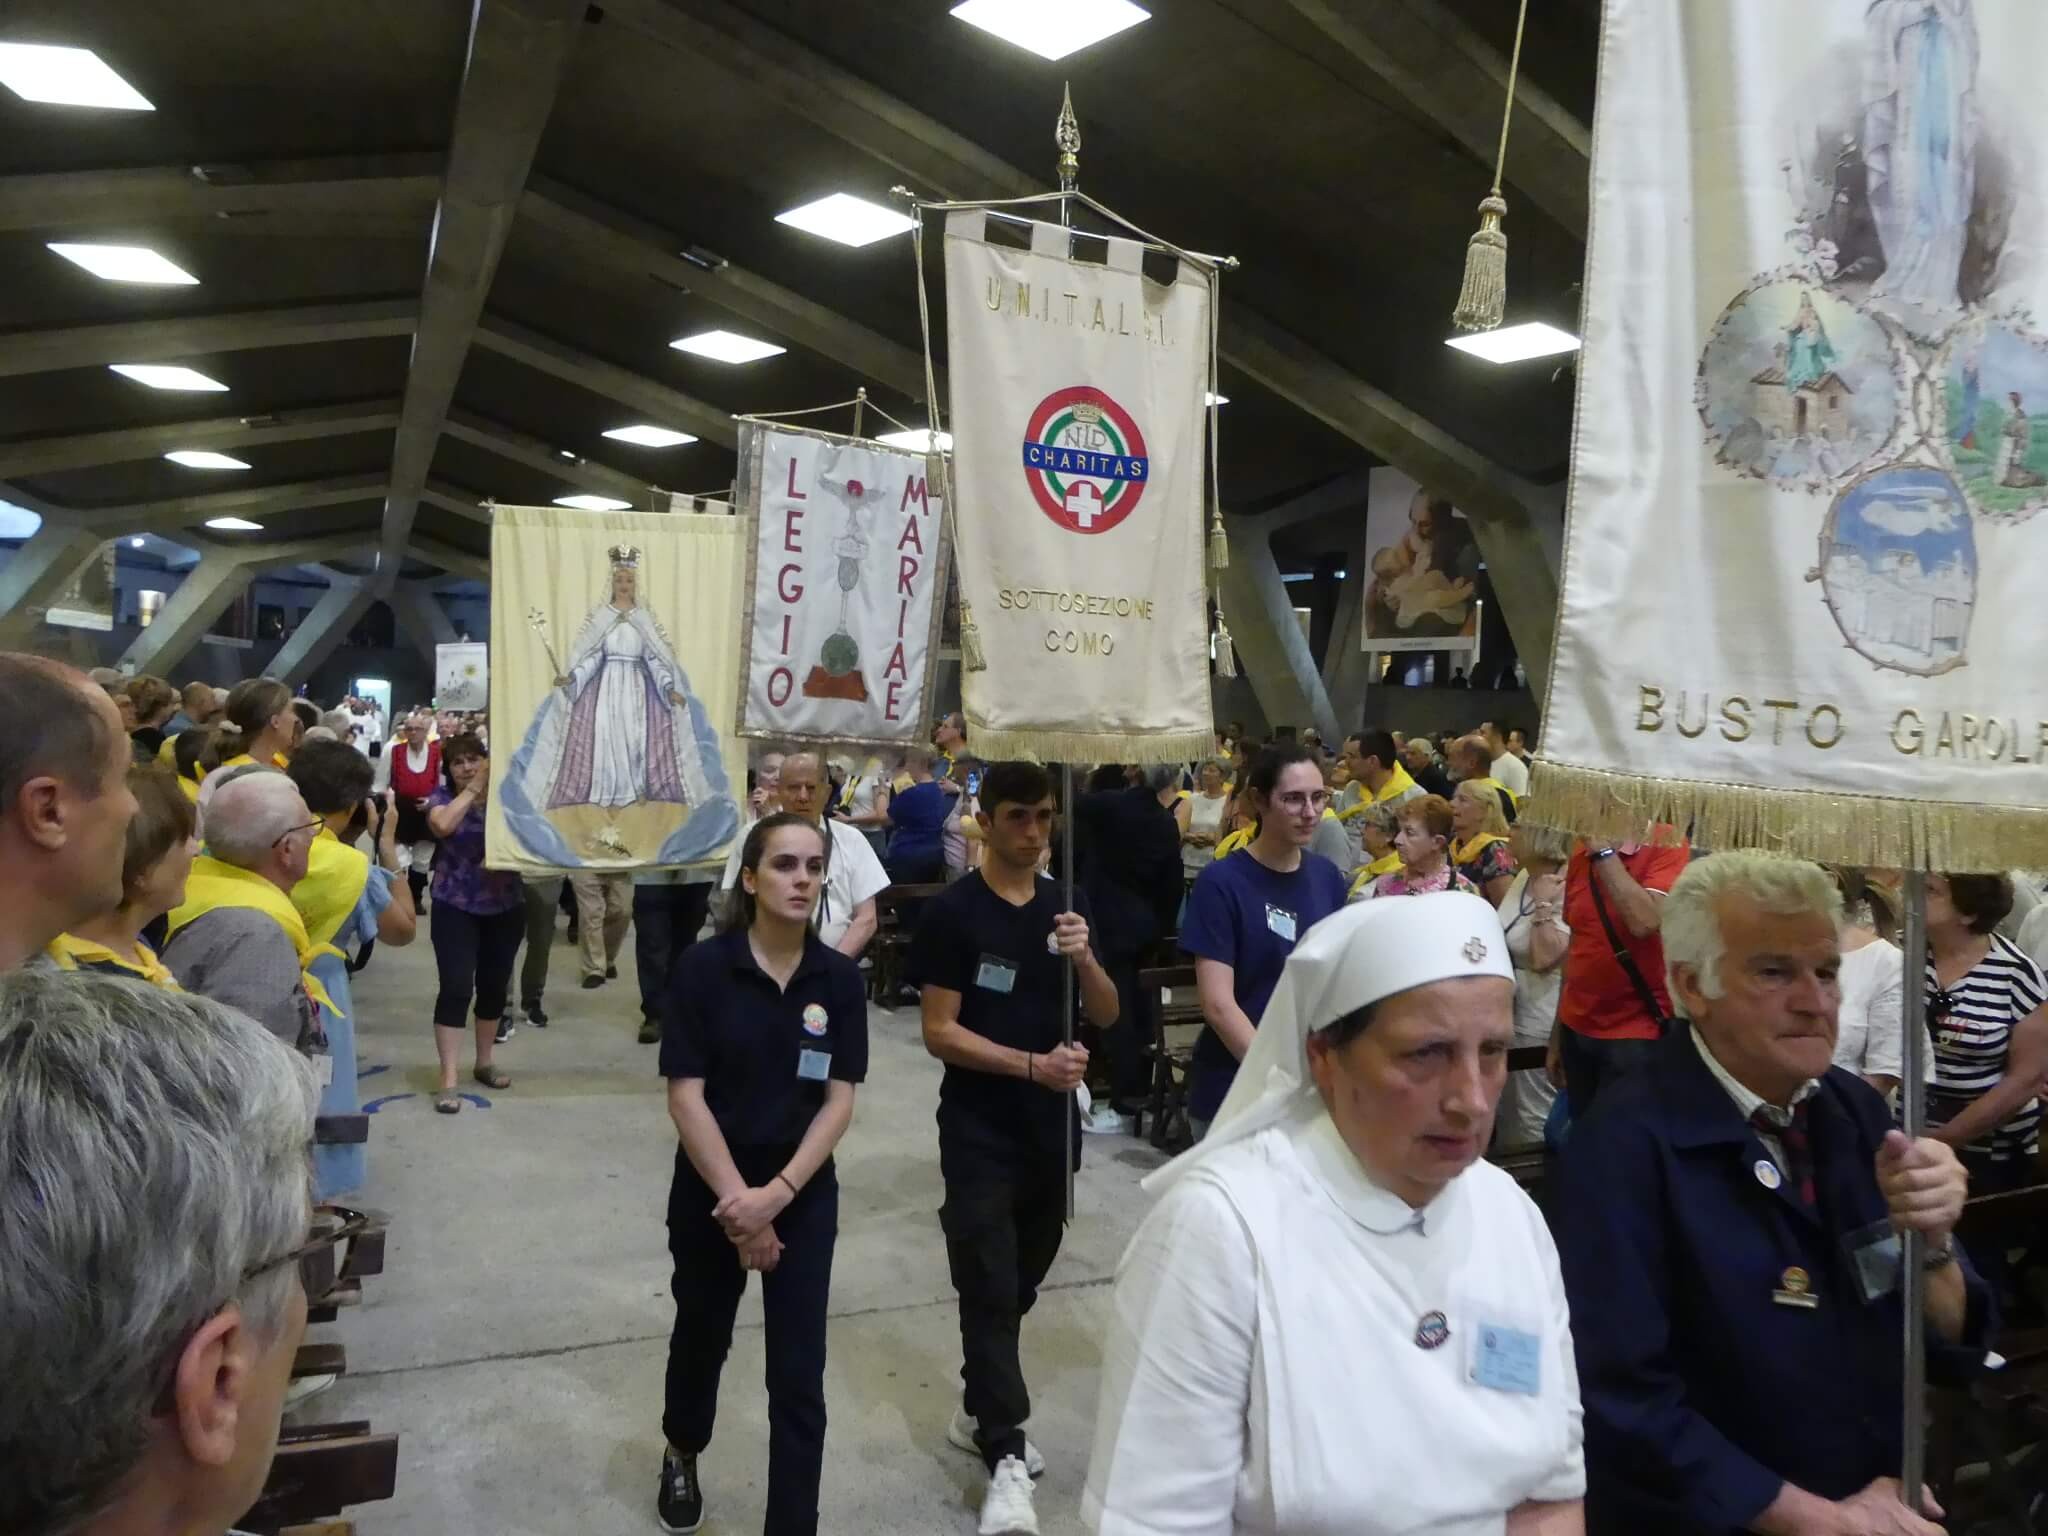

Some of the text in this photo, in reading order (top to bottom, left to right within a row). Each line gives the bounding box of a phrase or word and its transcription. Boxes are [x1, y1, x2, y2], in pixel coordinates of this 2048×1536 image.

[1029, 447, 1142, 477] CHARITAS
[767, 457, 807, 707] LEGIO
[883, 474, 929, 721] MARIAE
[999, 588, 1155, 621] SOTTOSEZIONE
[1045, 629, 1115, 657] COMO
[1636, 684, 1844, 750] BUSTO
